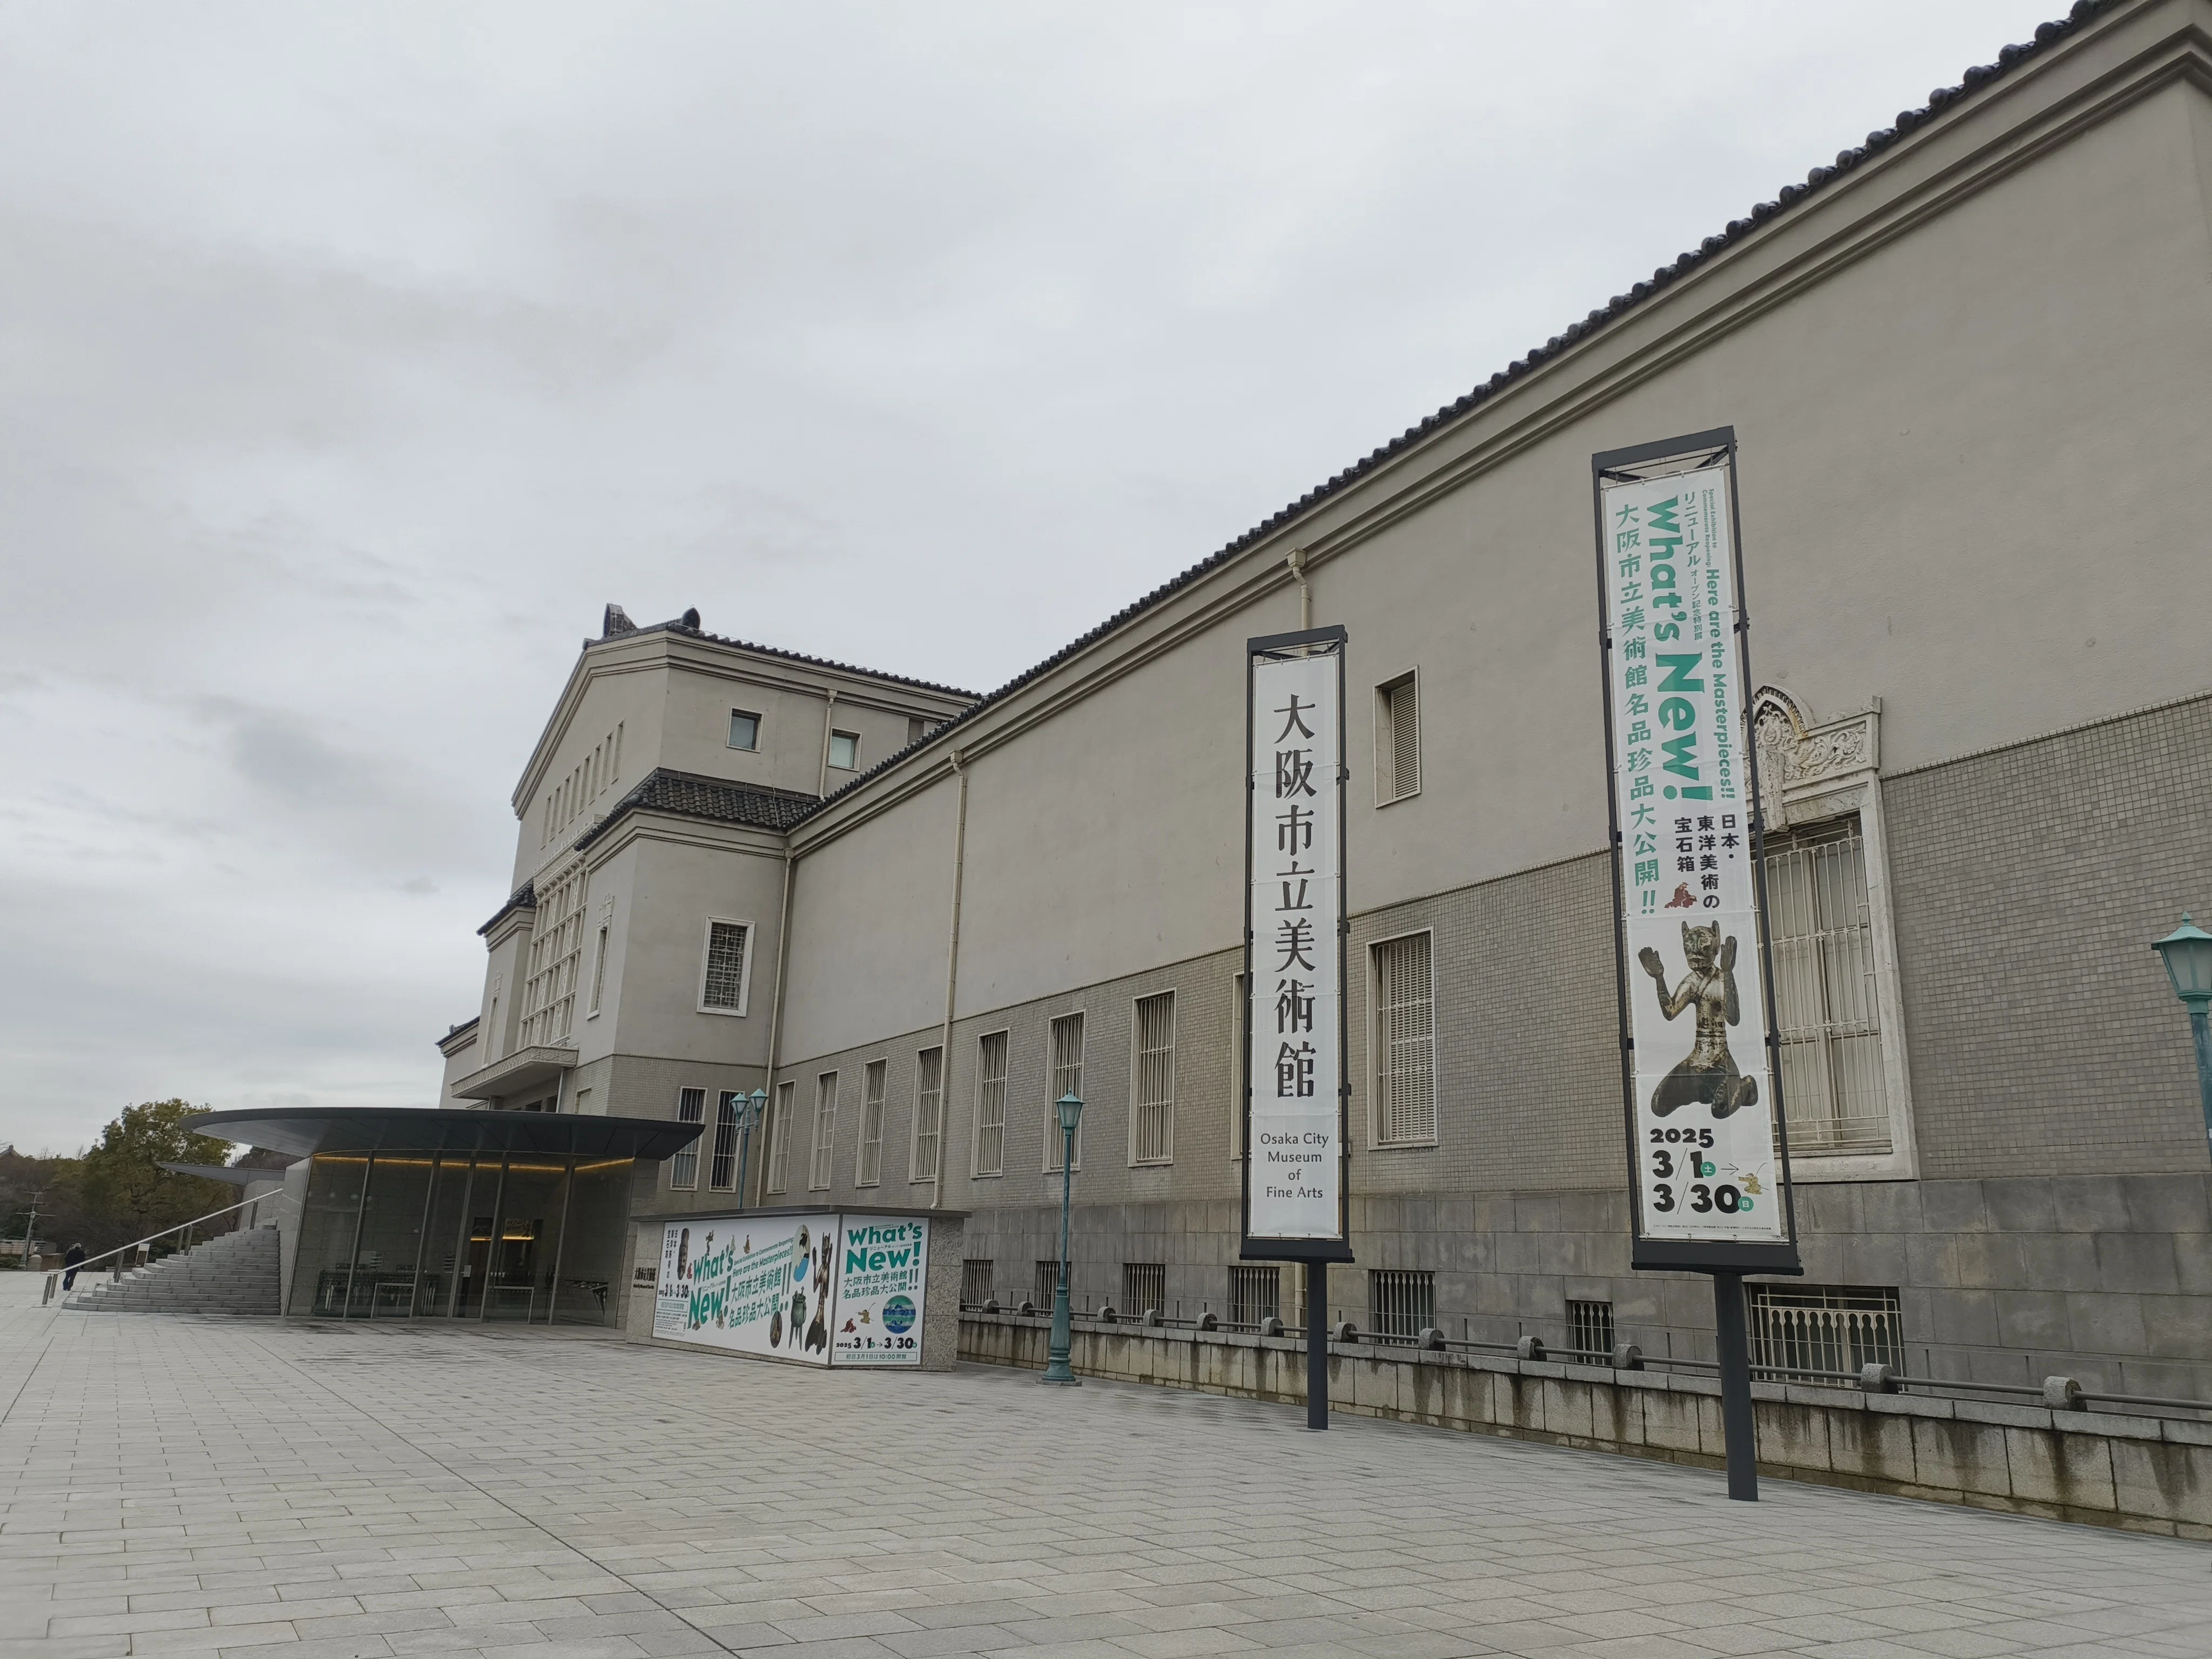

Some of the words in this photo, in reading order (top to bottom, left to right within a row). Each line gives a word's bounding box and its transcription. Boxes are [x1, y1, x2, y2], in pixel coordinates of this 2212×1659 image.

[1647, 495, 1688, 642] What's
[1707, 569, 1719, 605] Here
[1709, 611, 1721, 637] are
[1711, 642, 1725, 669] the
[1655, 651, 1713, 801] New!
[1713, 674, 1736, 799] Masterpieces!!
[1674, 817, 1695, 872] 宝石箱
[1697, 815, 1720, 908] 東洋美術の
[1273, 694, 1316, 1097] 大阪市立美術館
[1260, 1132, 1298, 1144] Osaka
[1303, 1132, 1328, 1148] City
[1650, 1128, 1714, 1148] 2025
[1268, 1151, 1321, 1162] Museum
[1288, 1169, 1301, 1180] of
[1266, 1186, 1292, 1198] Fine
[1297, 1186, 1323, 1198] Arts
[847, 1222, 922, 1246] What's
[693, 1244, 734, 1286] What's
[732, 1268, 743, 1278] Here
[750, 1261, 758, 1271] the
[845, 1242, 921, 1274] New!
[687, 1275, 731, 1330] New!
